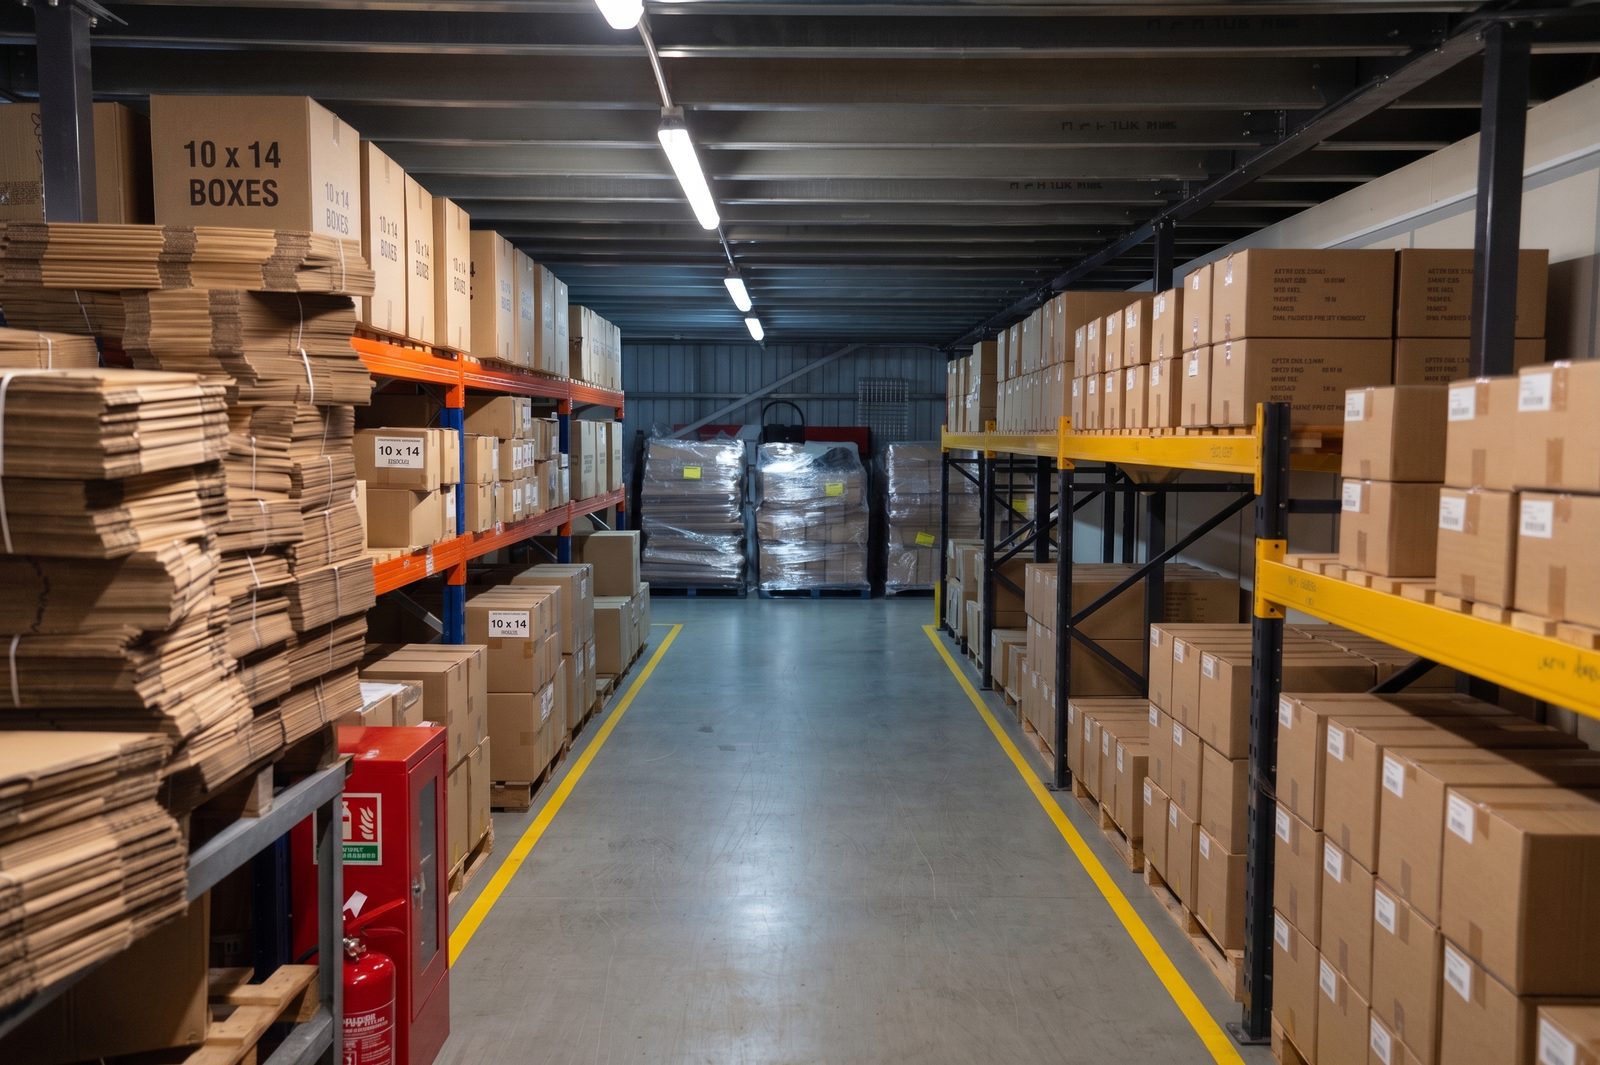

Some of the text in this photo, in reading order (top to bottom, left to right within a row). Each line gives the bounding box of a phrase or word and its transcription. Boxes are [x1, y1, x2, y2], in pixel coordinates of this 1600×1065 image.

[183, 140, 282, 169] 10 x 14
[189, 178, 279, 207] BOXES
[324, 181, 350, 211] 10 x 14
[325, 207, 349, 235] BOXES
[379, 215, 387, 235] 10
[391, 221, 398, 240] 14
[414, 239, 421, 256] 10
[378, 445, 420, 456] 10 x 14
[491, 619, 504, 628] 10
[514, 619, 527, 629] 14
